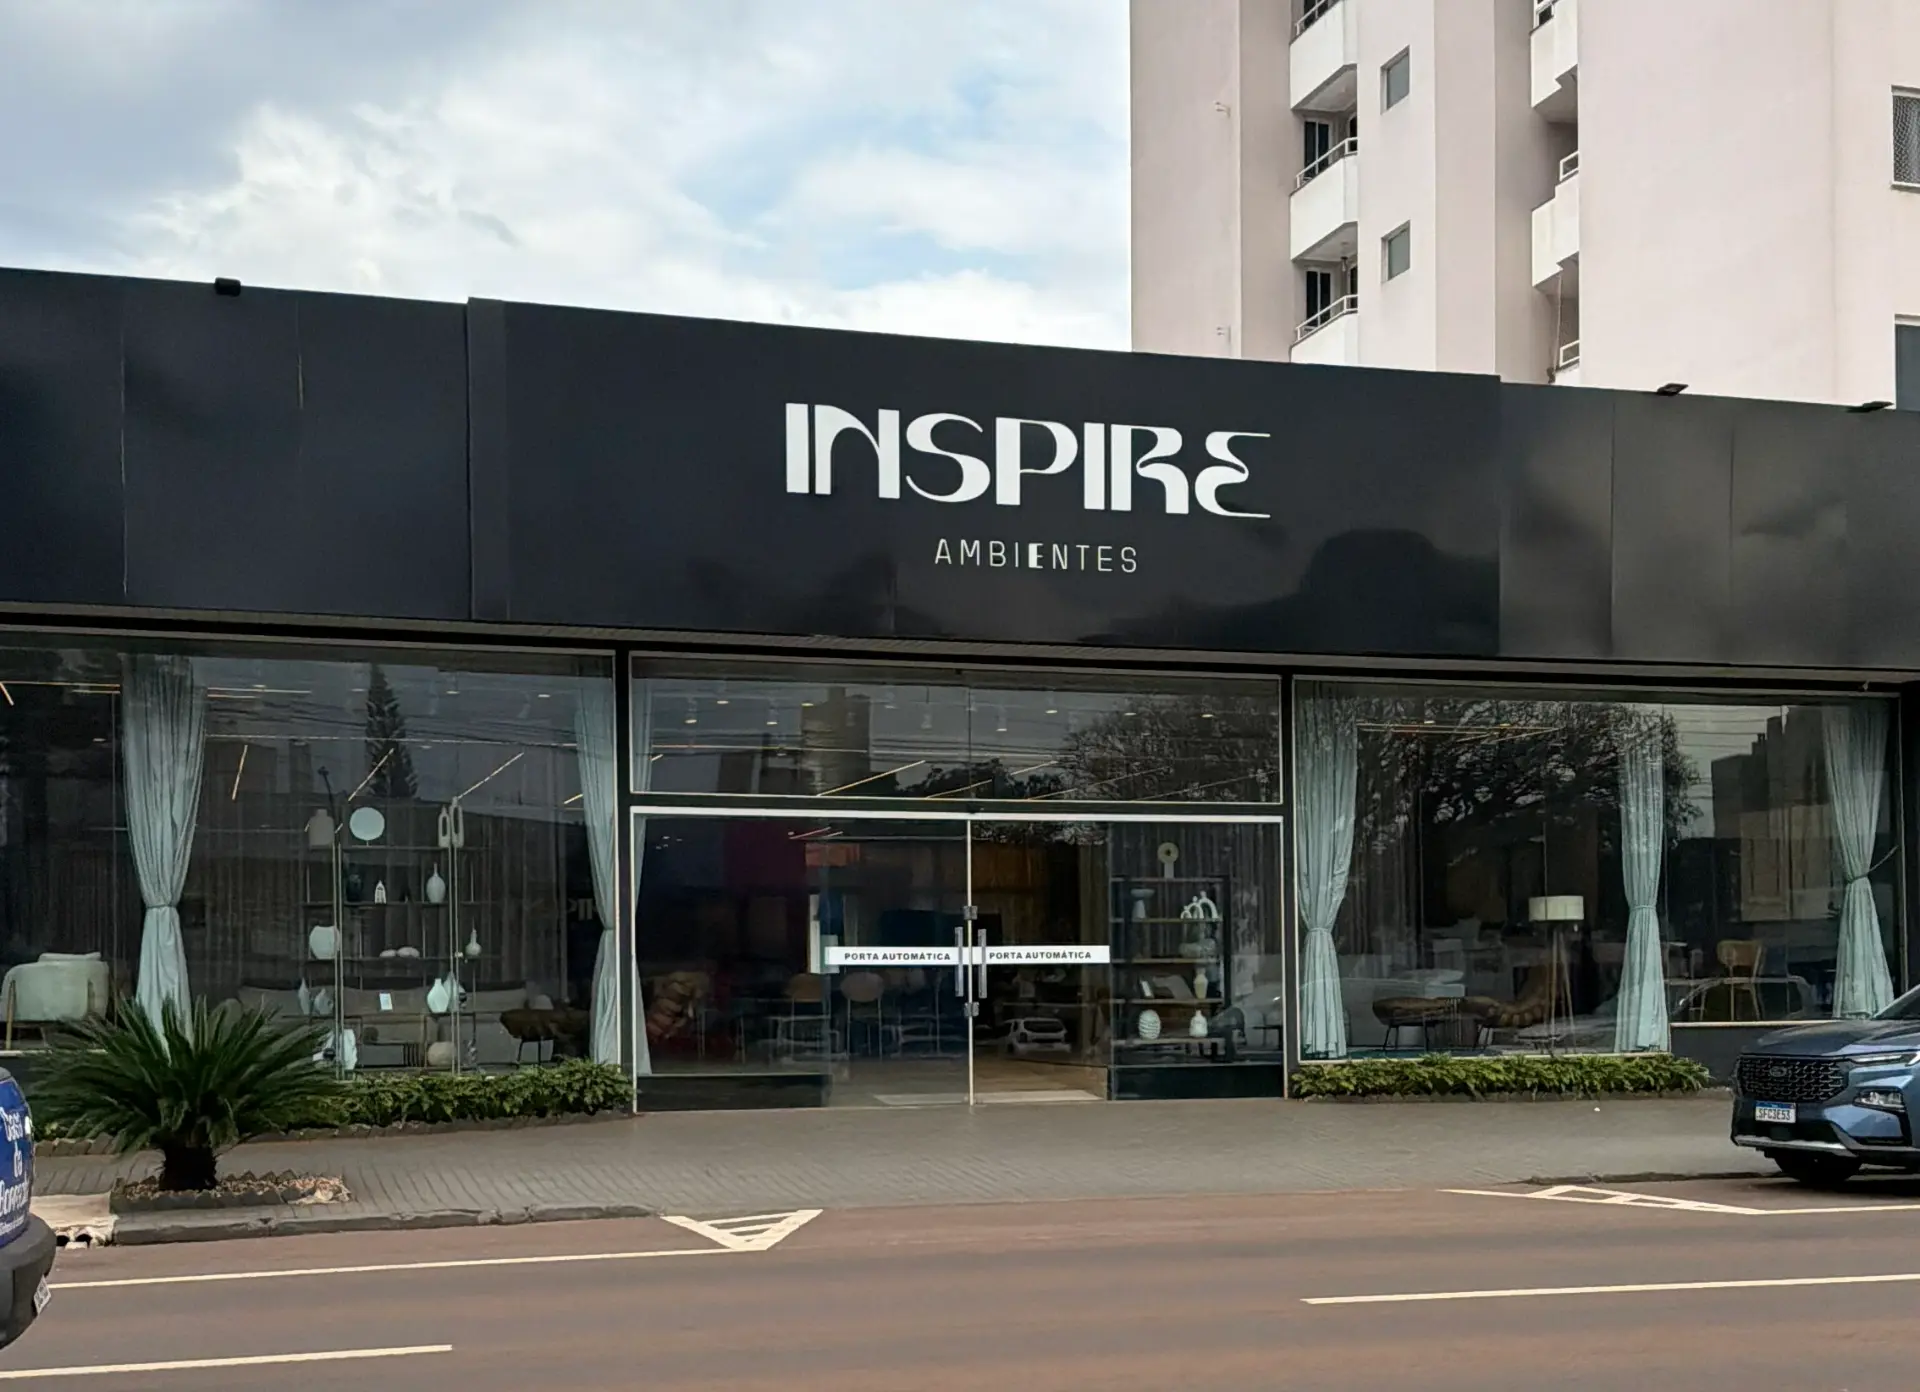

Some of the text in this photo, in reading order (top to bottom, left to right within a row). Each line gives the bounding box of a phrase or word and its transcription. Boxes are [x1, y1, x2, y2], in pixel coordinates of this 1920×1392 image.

[786, 402, 1271, 518] INSPIRE
[935, 538, 1137, 573] AMBIENTES
[844, 951, 951, 961] PORTA AUTOMÁTICA
[989, 949, 1092, 960] PORTA AUTOMÁTICA
